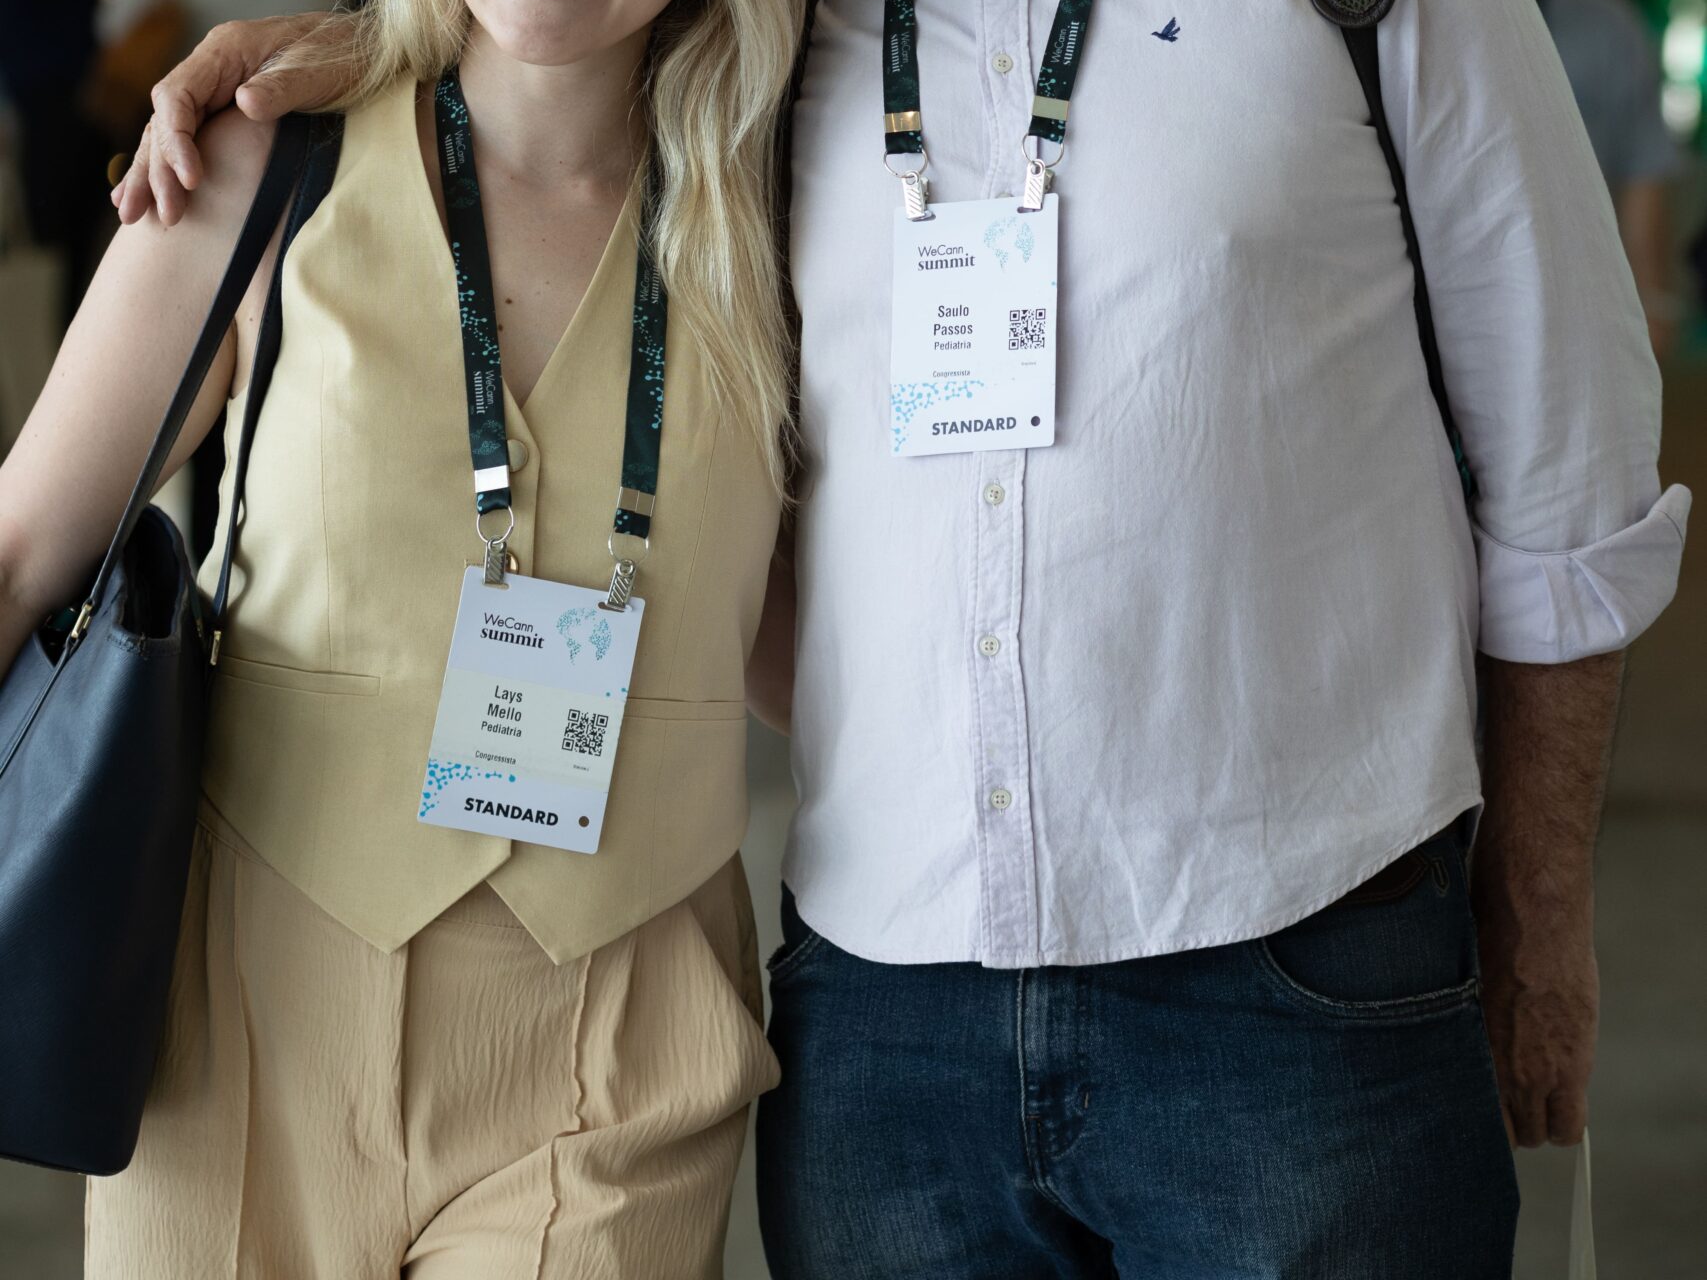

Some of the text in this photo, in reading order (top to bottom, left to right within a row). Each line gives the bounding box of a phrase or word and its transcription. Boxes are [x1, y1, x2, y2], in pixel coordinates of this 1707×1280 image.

[1050, 28, 1067, 63] WeCann
[1063, 21, 1080, 65] summit
[444, 134, 460, 174] summit
[454, 130, 466, 164] WeCann
[917, 244, 964, 258] WeCann
[917, 253, 976, 271] summit
[937, 304, 970, 318] Saulo
[933, 323, 974, 336] Passos
[934, 340, 972, 351] Pediatria
[932, 369, 971, 378] Congressista
[474, 371, 488, 414] summit
[485, 370, 496, 405] WeCann
[932, 417, 1017, 436] STANDARD
[483, 612, 534, 633] WeCann
[480, 626, 545, 649] summit
[494, 685, 523, 703] Lays
[487, 703, 522, 722] Mello
[481, 721, 522, 738] Pediatria
[475, 750, 517, 765] Congressista
[464, 797, 559, 826] STANDARD
